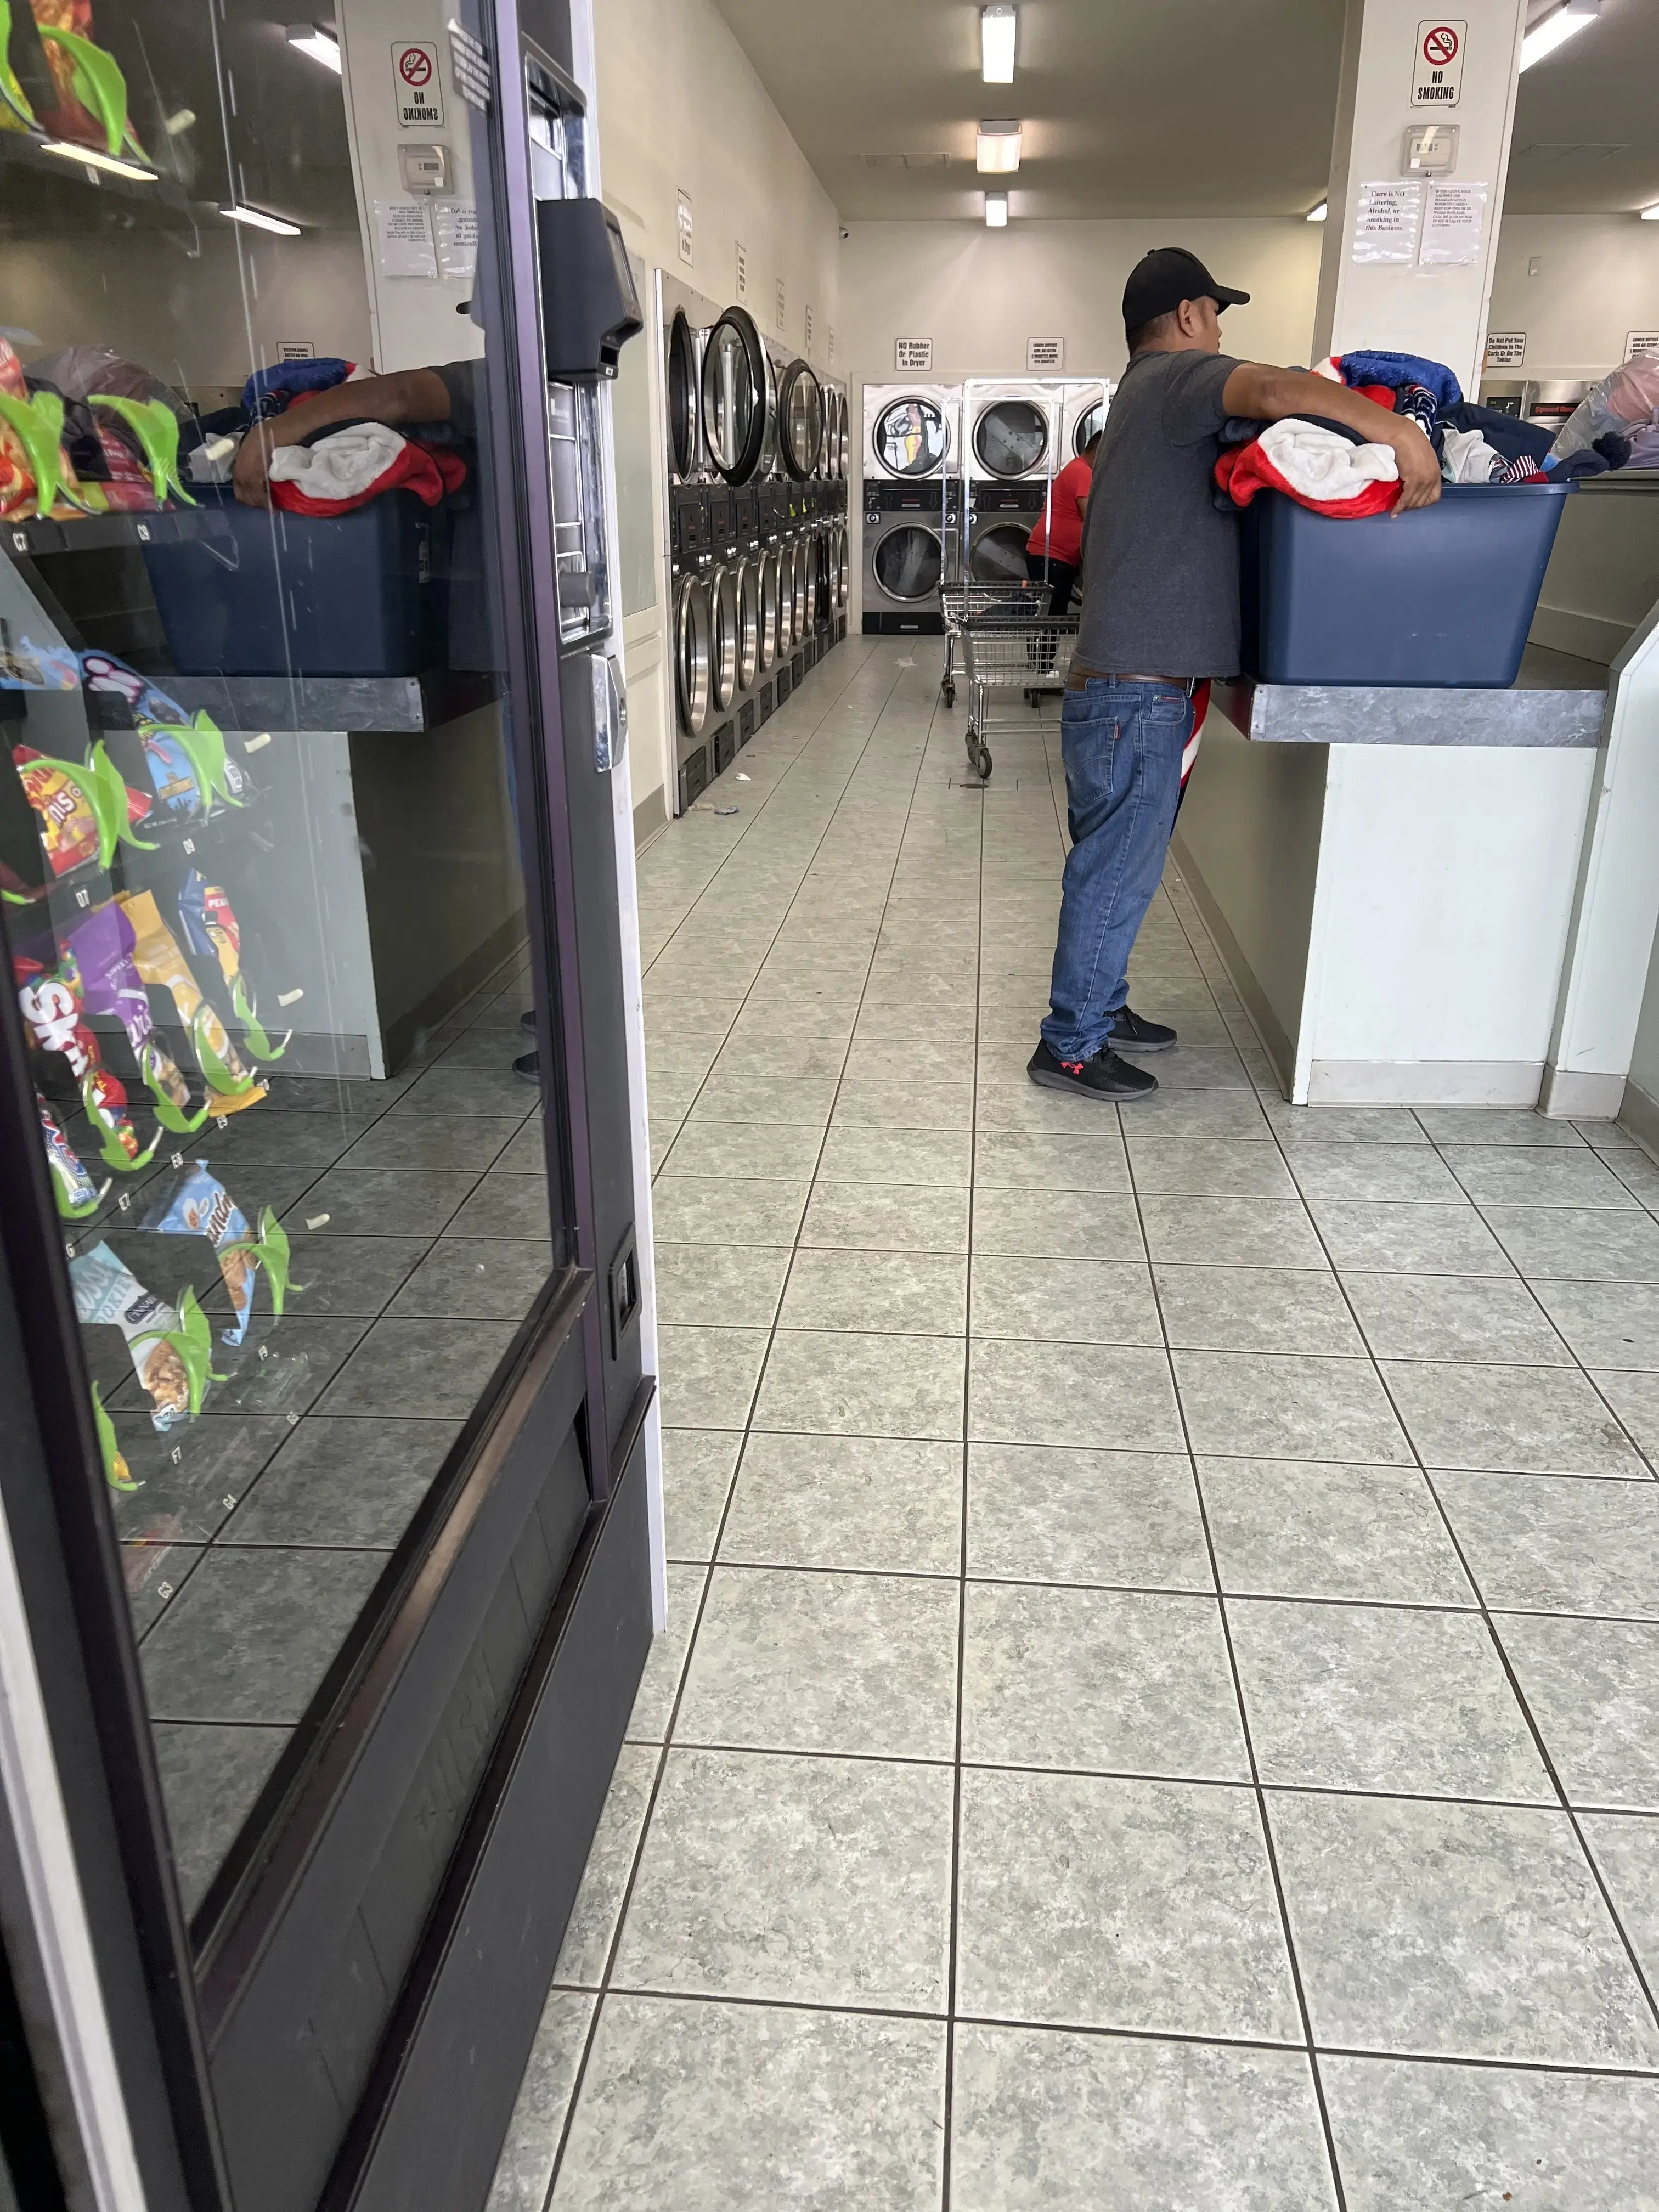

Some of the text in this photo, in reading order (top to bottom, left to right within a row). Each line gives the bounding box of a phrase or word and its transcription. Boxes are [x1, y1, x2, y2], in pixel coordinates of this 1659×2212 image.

[1431, 71, 1443, 83] NO
[1418, 87, 1454, 100] SMOKING
[65, 1243, 76, 1258] 6
[171, 1446, 182, 1464] F7
[157, 1581, 174, 1599] G3
